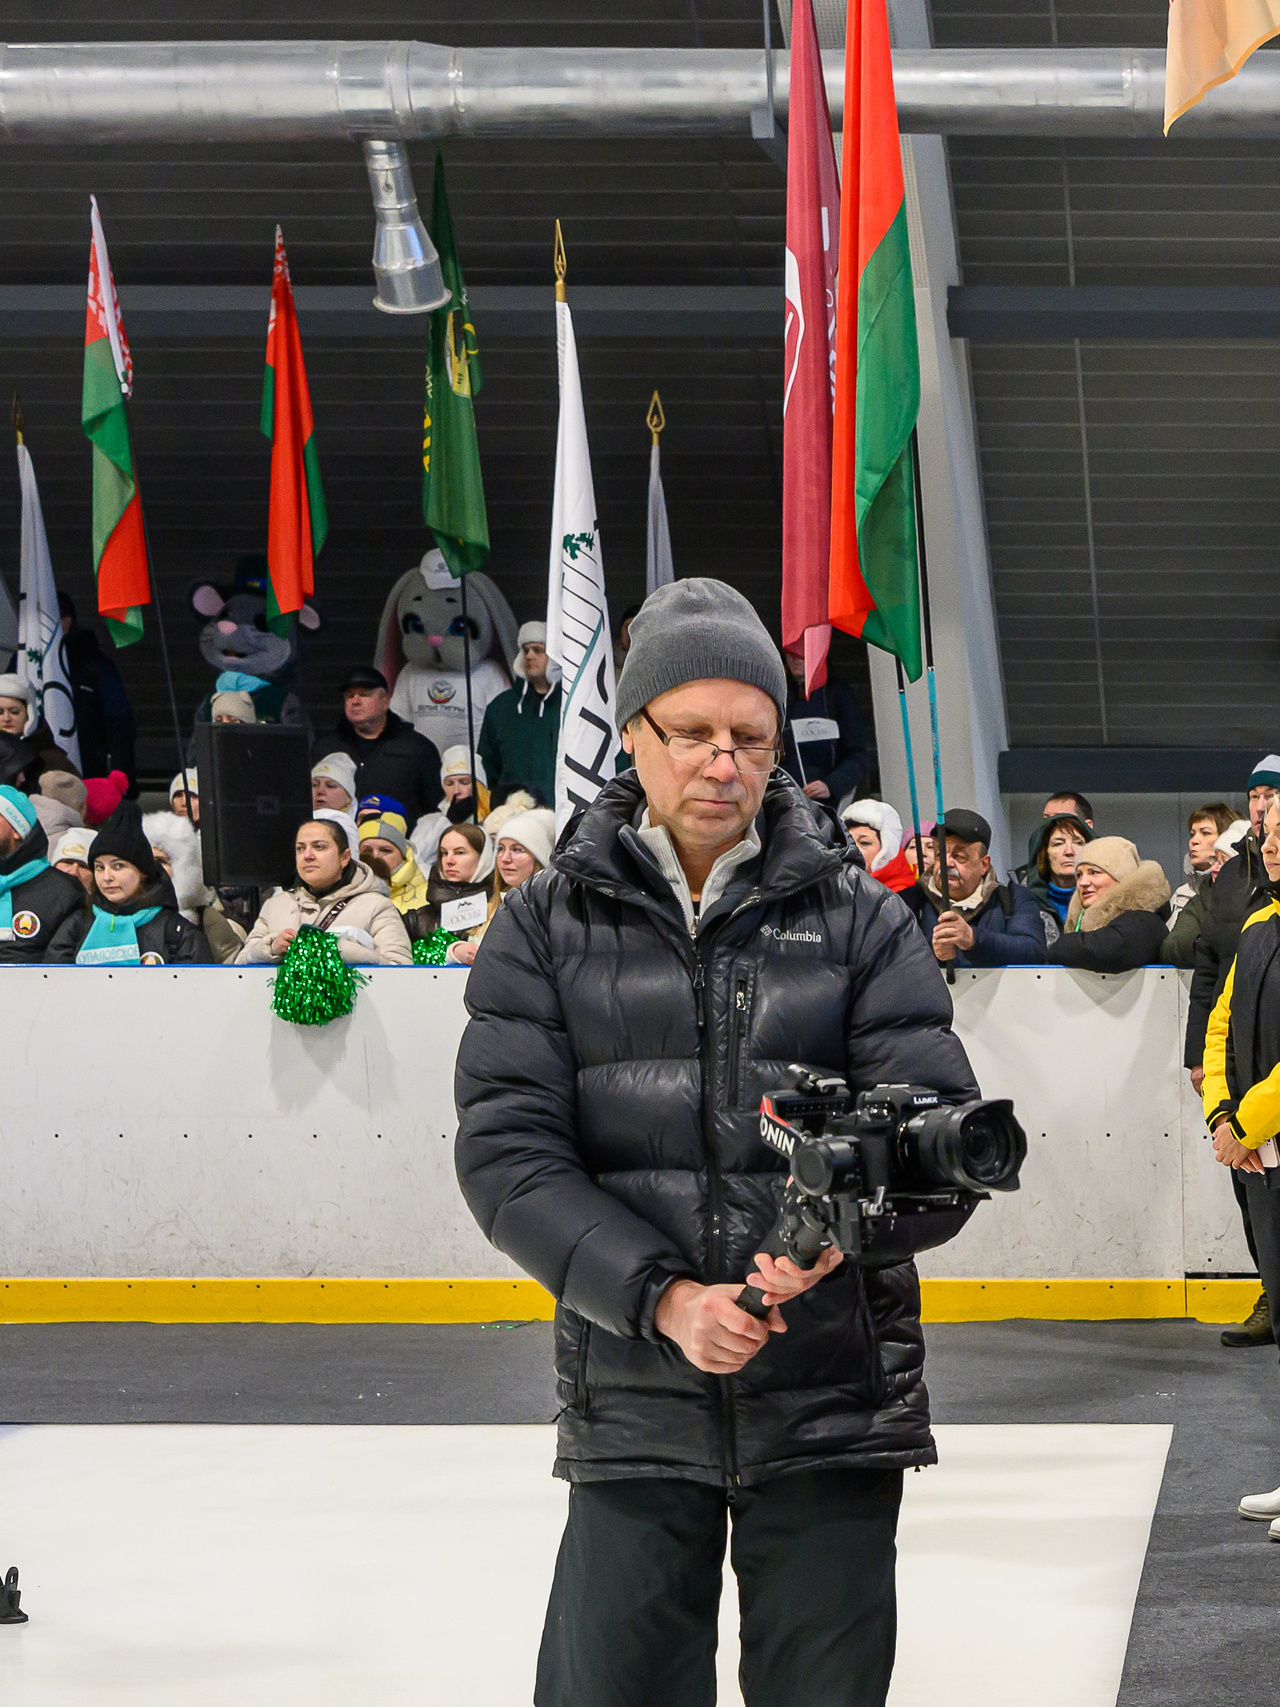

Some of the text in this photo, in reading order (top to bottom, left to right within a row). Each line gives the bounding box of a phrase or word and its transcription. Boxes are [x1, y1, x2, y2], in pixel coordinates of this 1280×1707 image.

[772, 927, 822, 943] Columbia
[913, 1096, 939, 1105] LUMIX
[760, 1112, 796, 1156] ONIN
